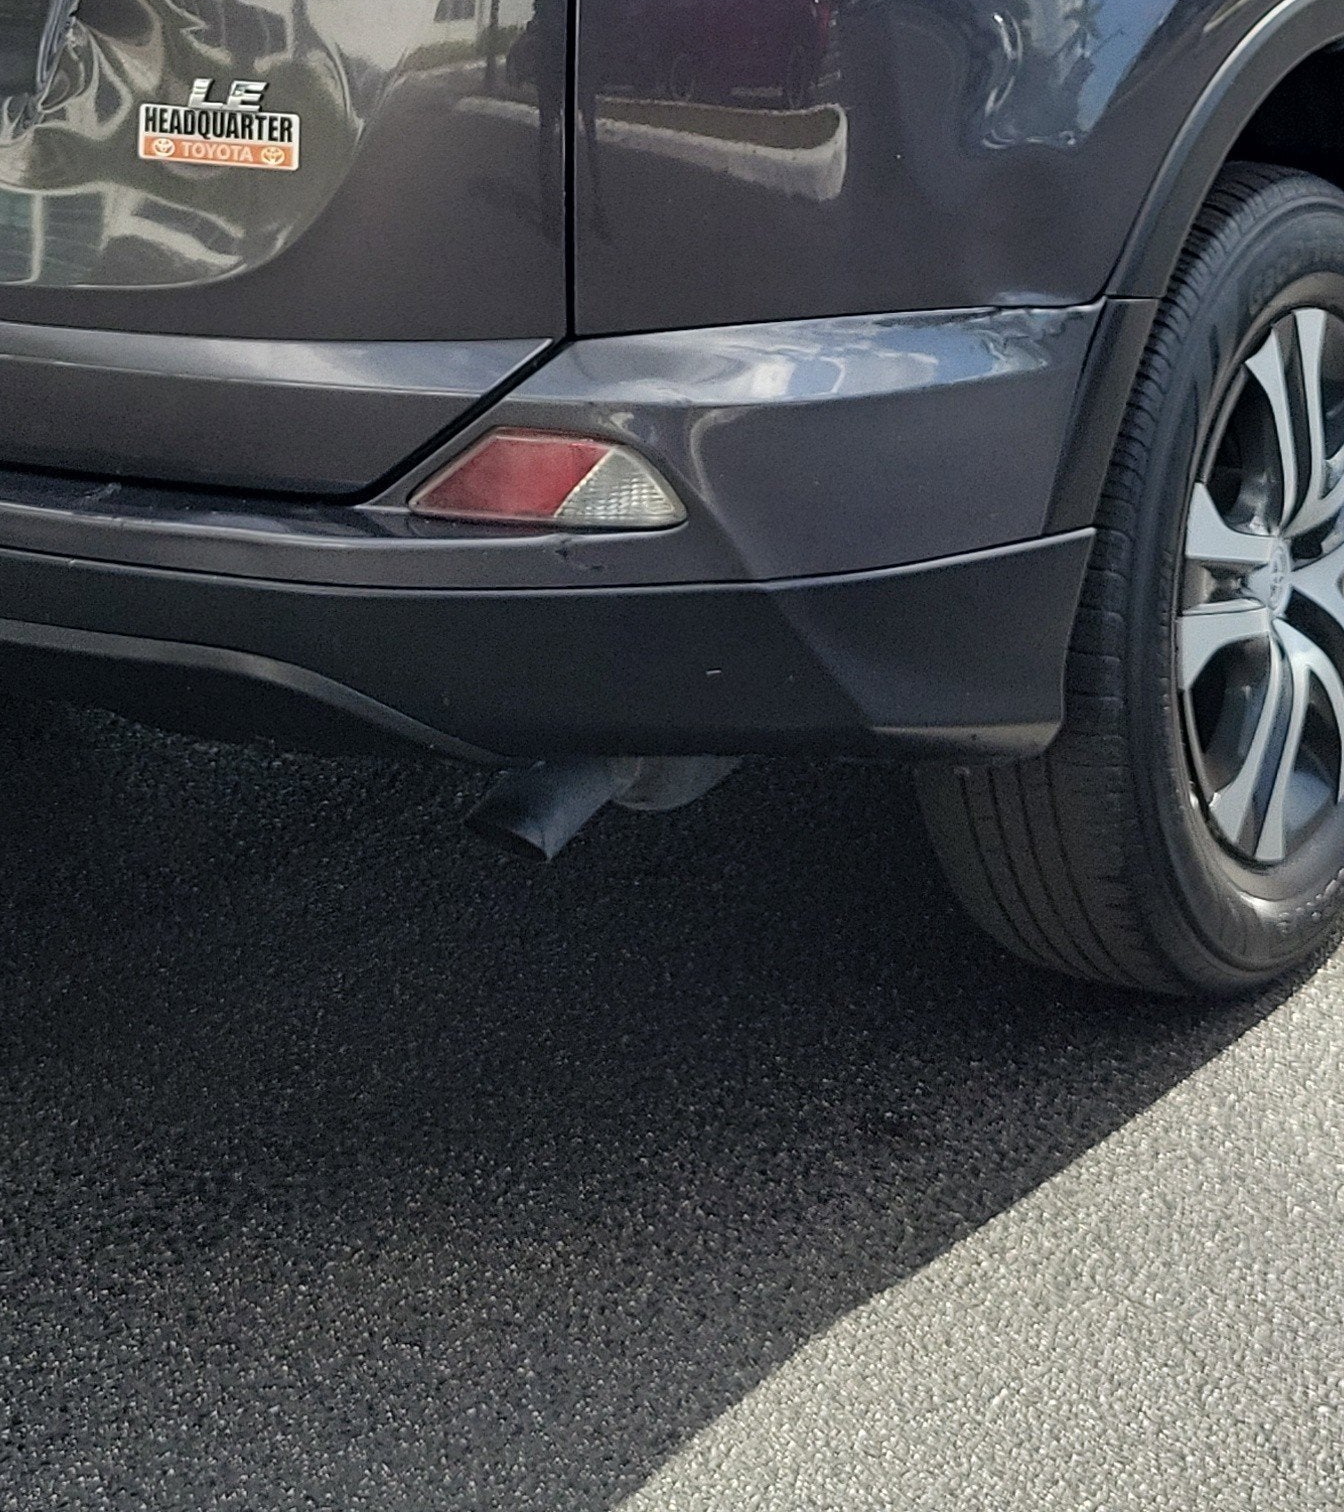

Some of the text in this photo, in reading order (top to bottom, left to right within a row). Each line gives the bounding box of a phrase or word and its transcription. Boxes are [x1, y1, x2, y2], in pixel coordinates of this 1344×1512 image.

[188, 78, 267, 112] LE
[144, 106, 294, 143] HEADQUARTER
[181, 140, 254, 162] TOYOTA
